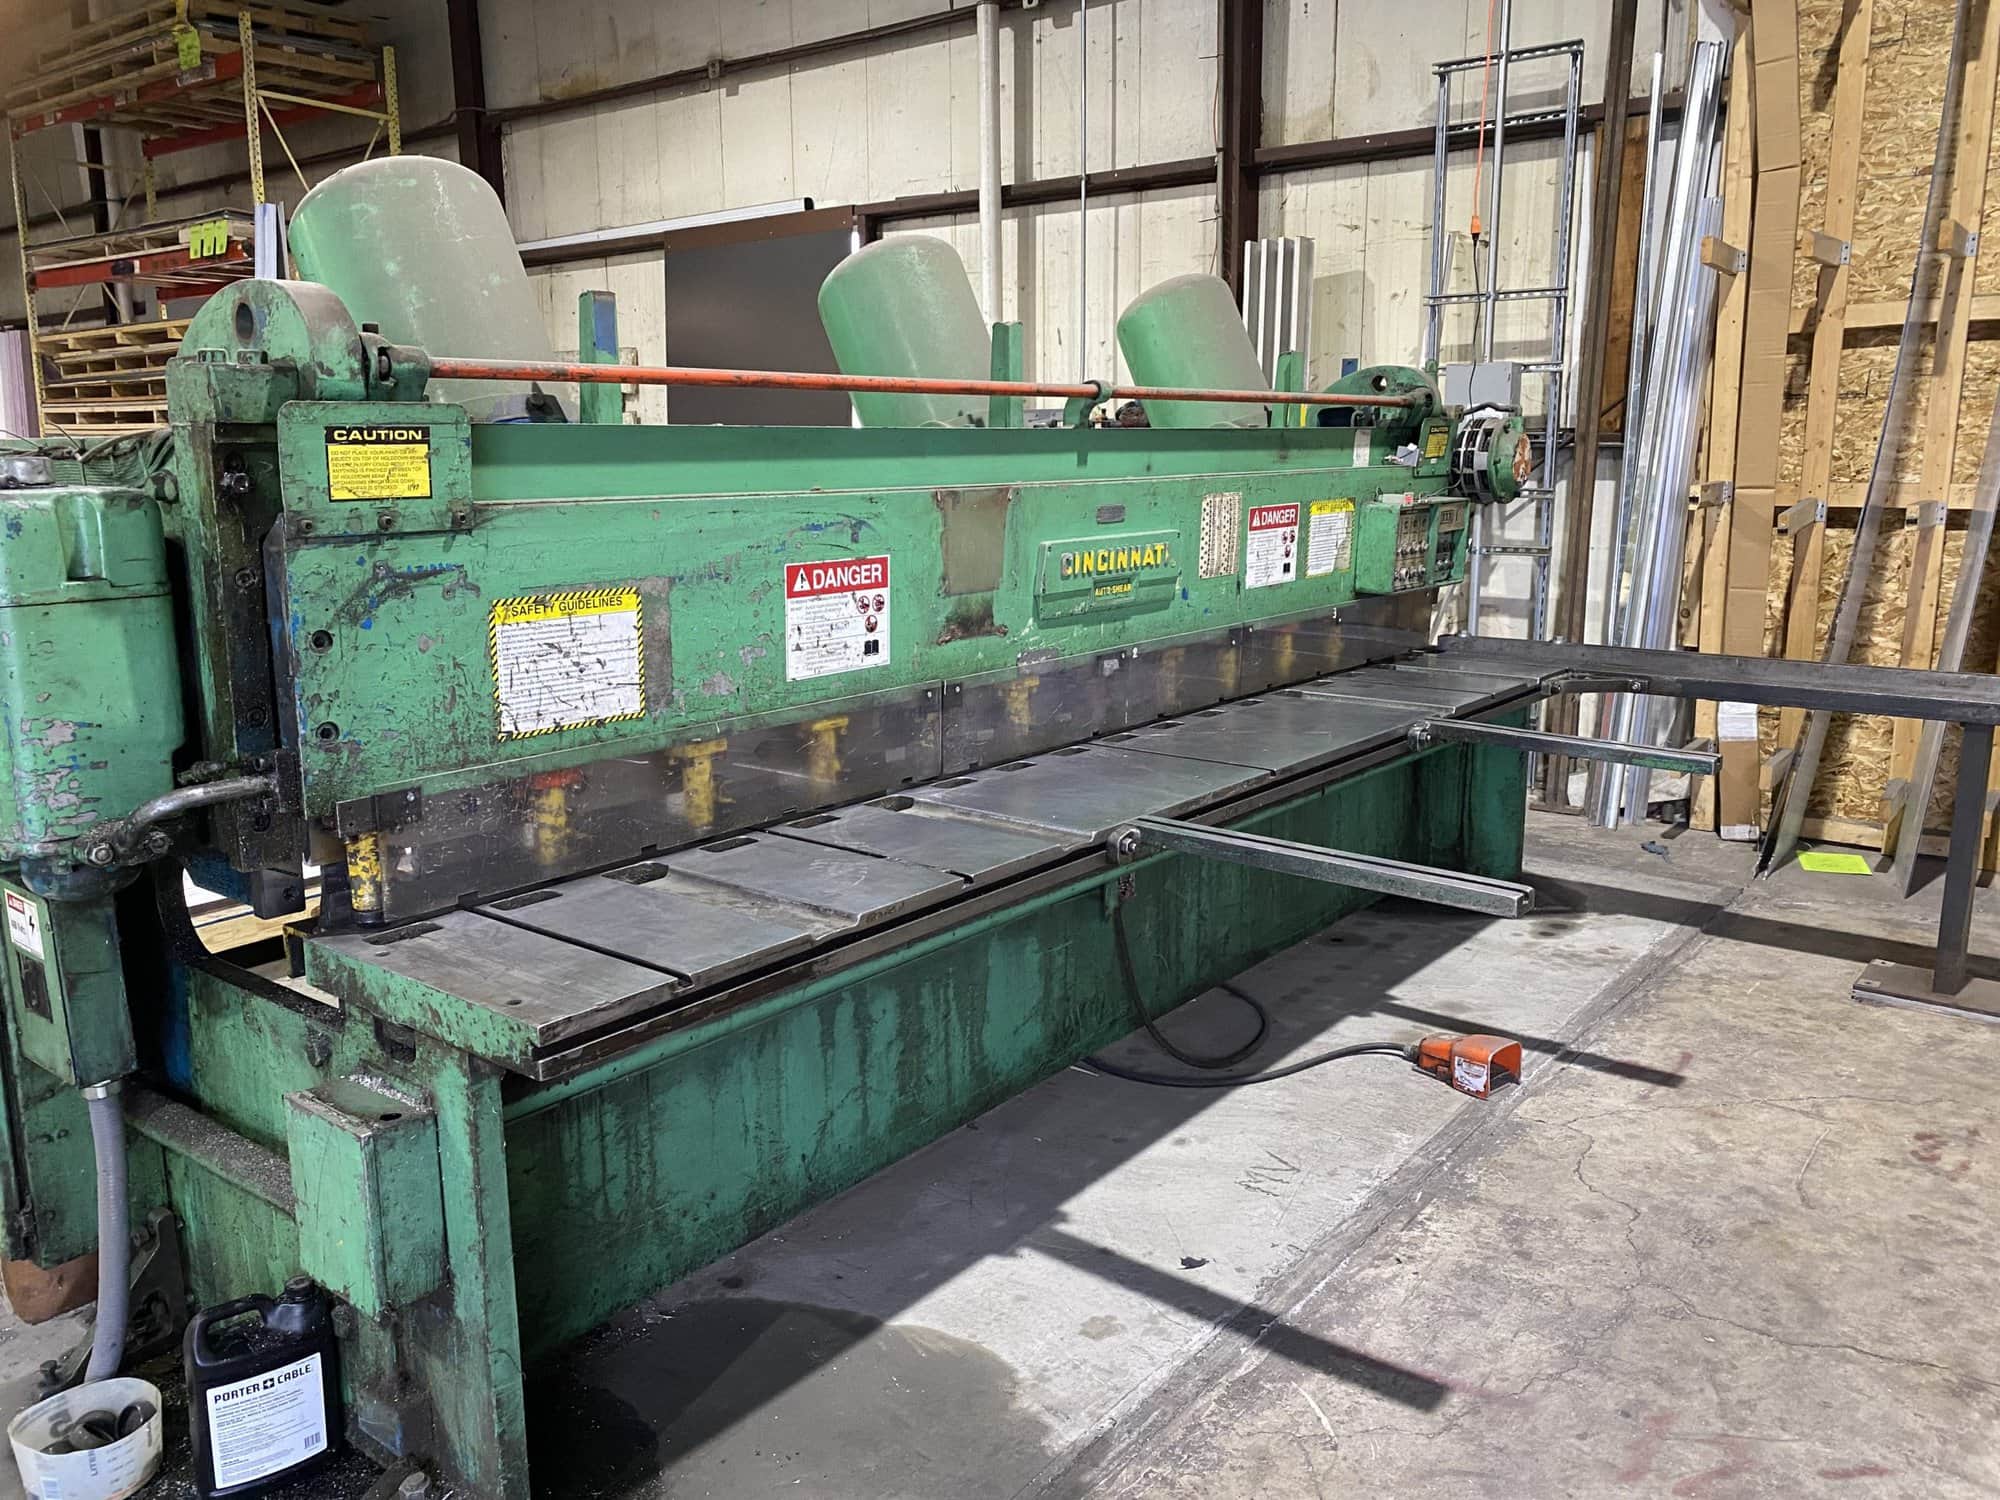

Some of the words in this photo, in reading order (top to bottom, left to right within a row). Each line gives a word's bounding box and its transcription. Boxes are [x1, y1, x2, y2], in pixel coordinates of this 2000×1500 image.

[333, 429, 422, 441] CAUTION
[1261, 508, 1296, 525] DANGER
[812, 563, 882, 590] DANGER
[510, 602, 555, 617] SAFETY
[558, 596, 623, 612] GUIDELINES
[213, 1383, 260, 1404] PORTER
[277, 1363, 312, 1385] CABLE
